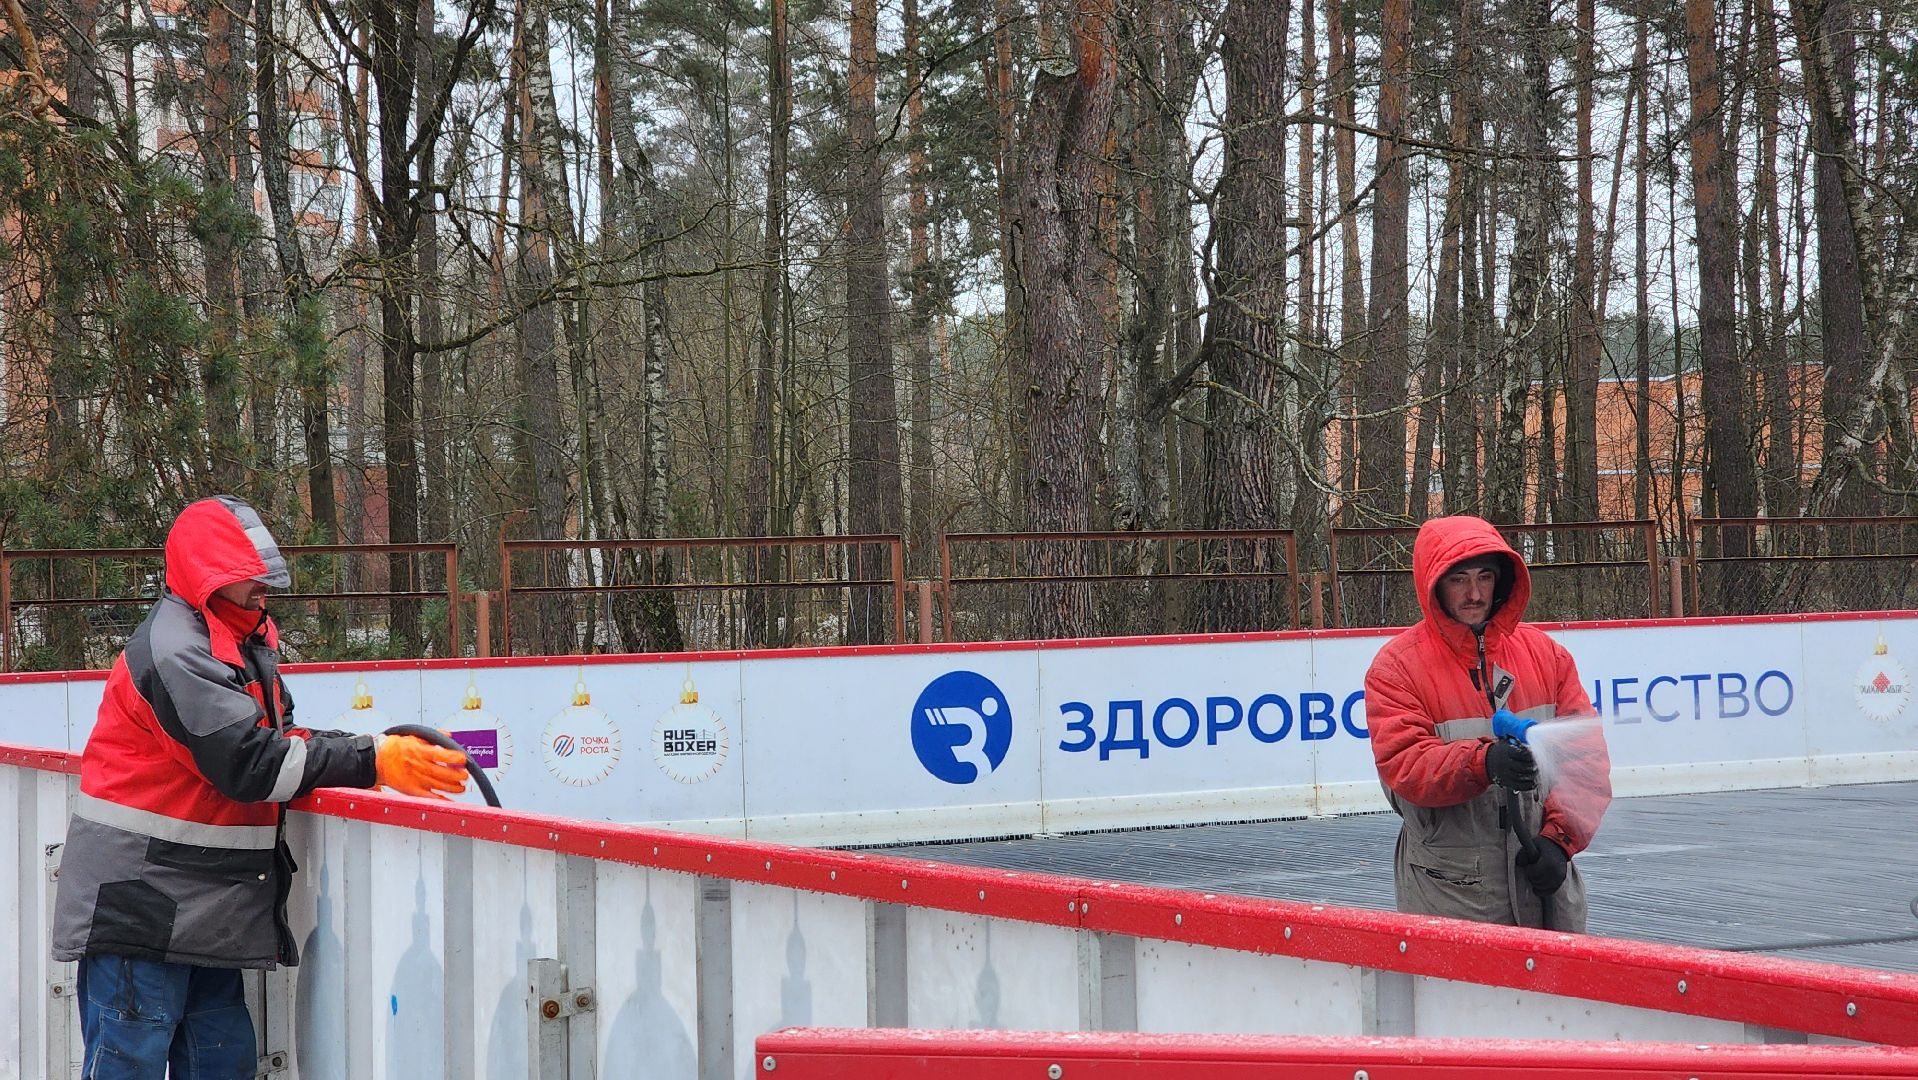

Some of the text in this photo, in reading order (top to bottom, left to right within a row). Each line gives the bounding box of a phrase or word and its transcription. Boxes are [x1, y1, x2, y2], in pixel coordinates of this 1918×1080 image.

[664, 729, 696, 740] RUS
[580, 737, 609, 745] ТОЧКА
[580, 746, 609, 754] РОСТА
[664, 740, 717, 752] BOXER
